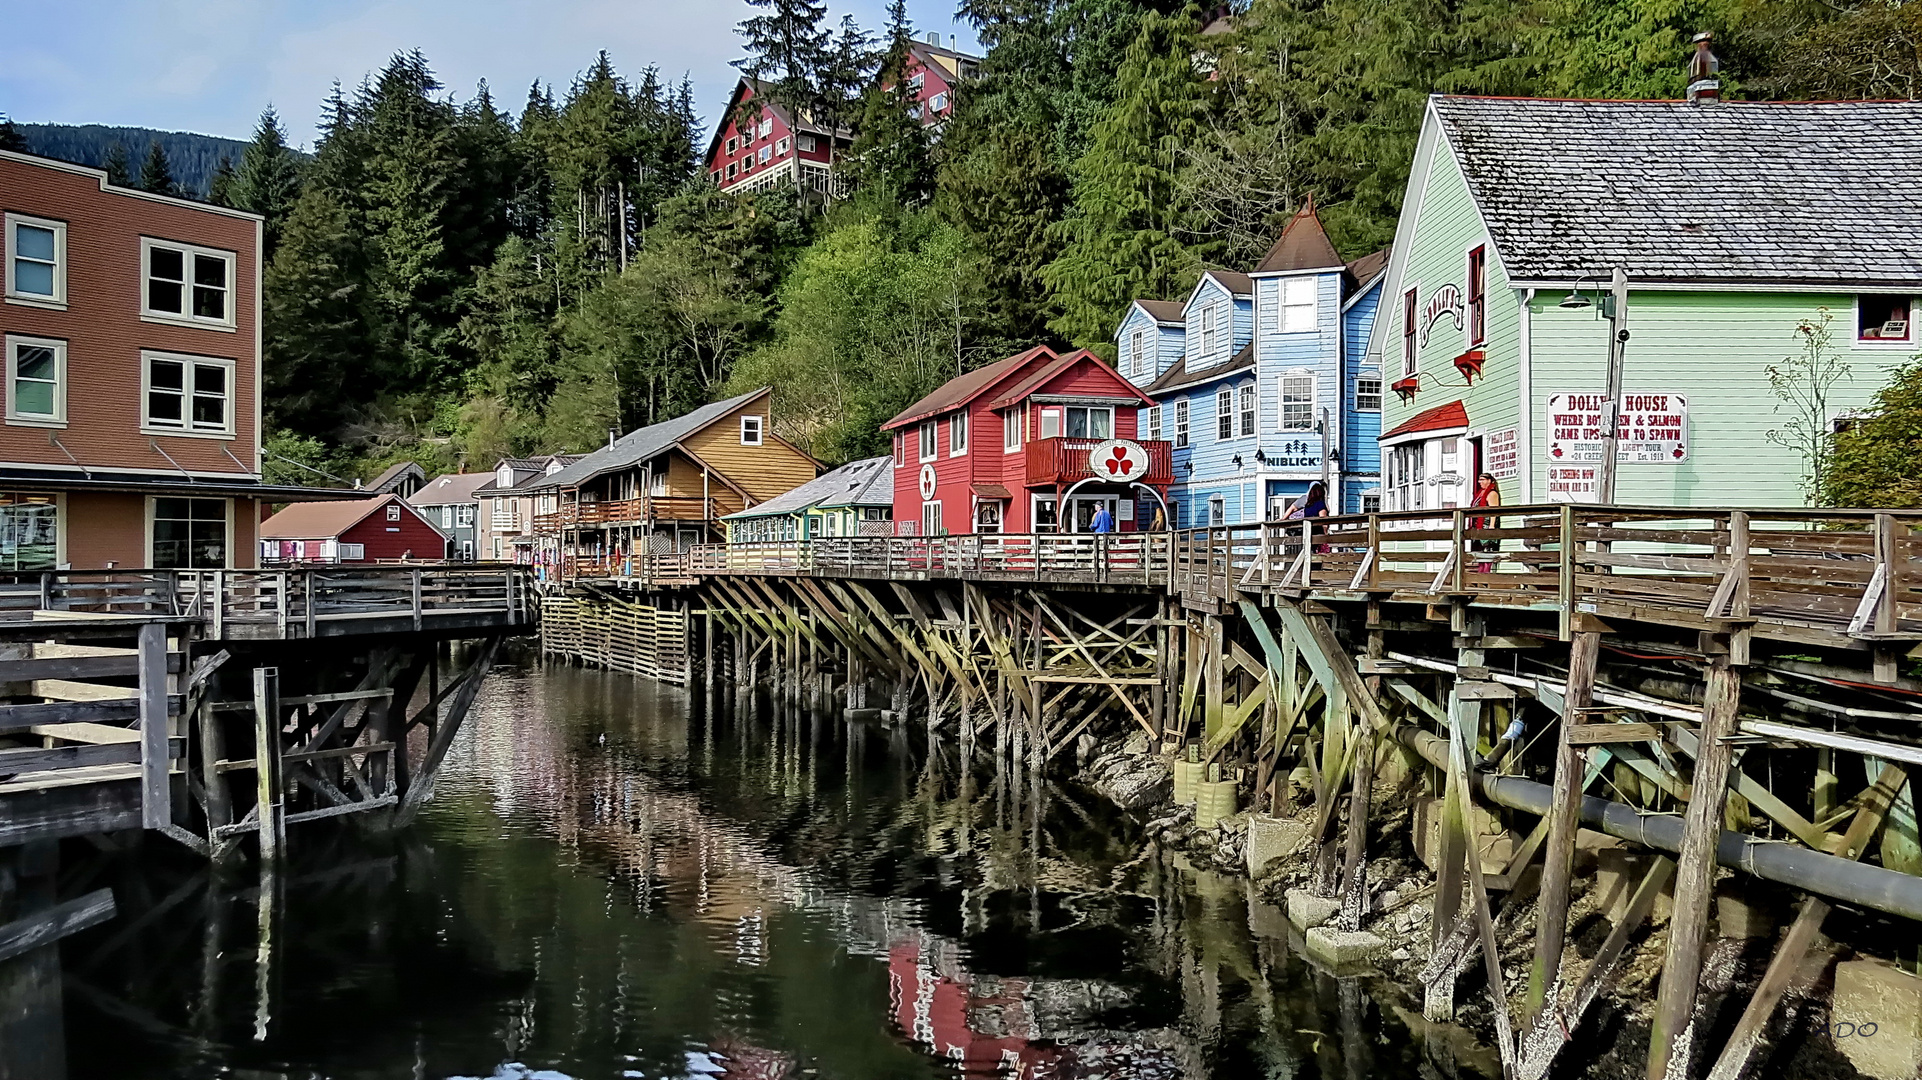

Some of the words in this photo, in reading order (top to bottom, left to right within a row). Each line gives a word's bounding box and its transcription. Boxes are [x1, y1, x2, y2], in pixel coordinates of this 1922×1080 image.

[1625, 395, 1668, 411] HOUSE
[1554, 414, 1583, 426] WHERE
[1586, 414, 1602, 426] BOT
[1617, 414, 1631, 427] EN
[1635, 415, 1645, 426] &
[1648, 414, 1682, 427] SALMON
[1554, 428, 1579, 440] CAME
[1633, 428, 1645, 441] TO
[1649, 428, 1681, 441] SPAWN
[1573, 443, 1602, 452] HISTORIC
[1644, 443, 1662, 452] TOUR
[1266, 457, 1323, 467] NIBLICK'
[1650, 452, 1664, 461] 1919
[1550, 468, 1558, 480] GO
[1559, 468, 1581, 480] FISHING
[1582, 468, 1595, 480] NOW
[1550, 482, 1570, 493] SALMON
[1571, 482, 1582, 493] ARE
[1582, 482, 1590, 493] IN
